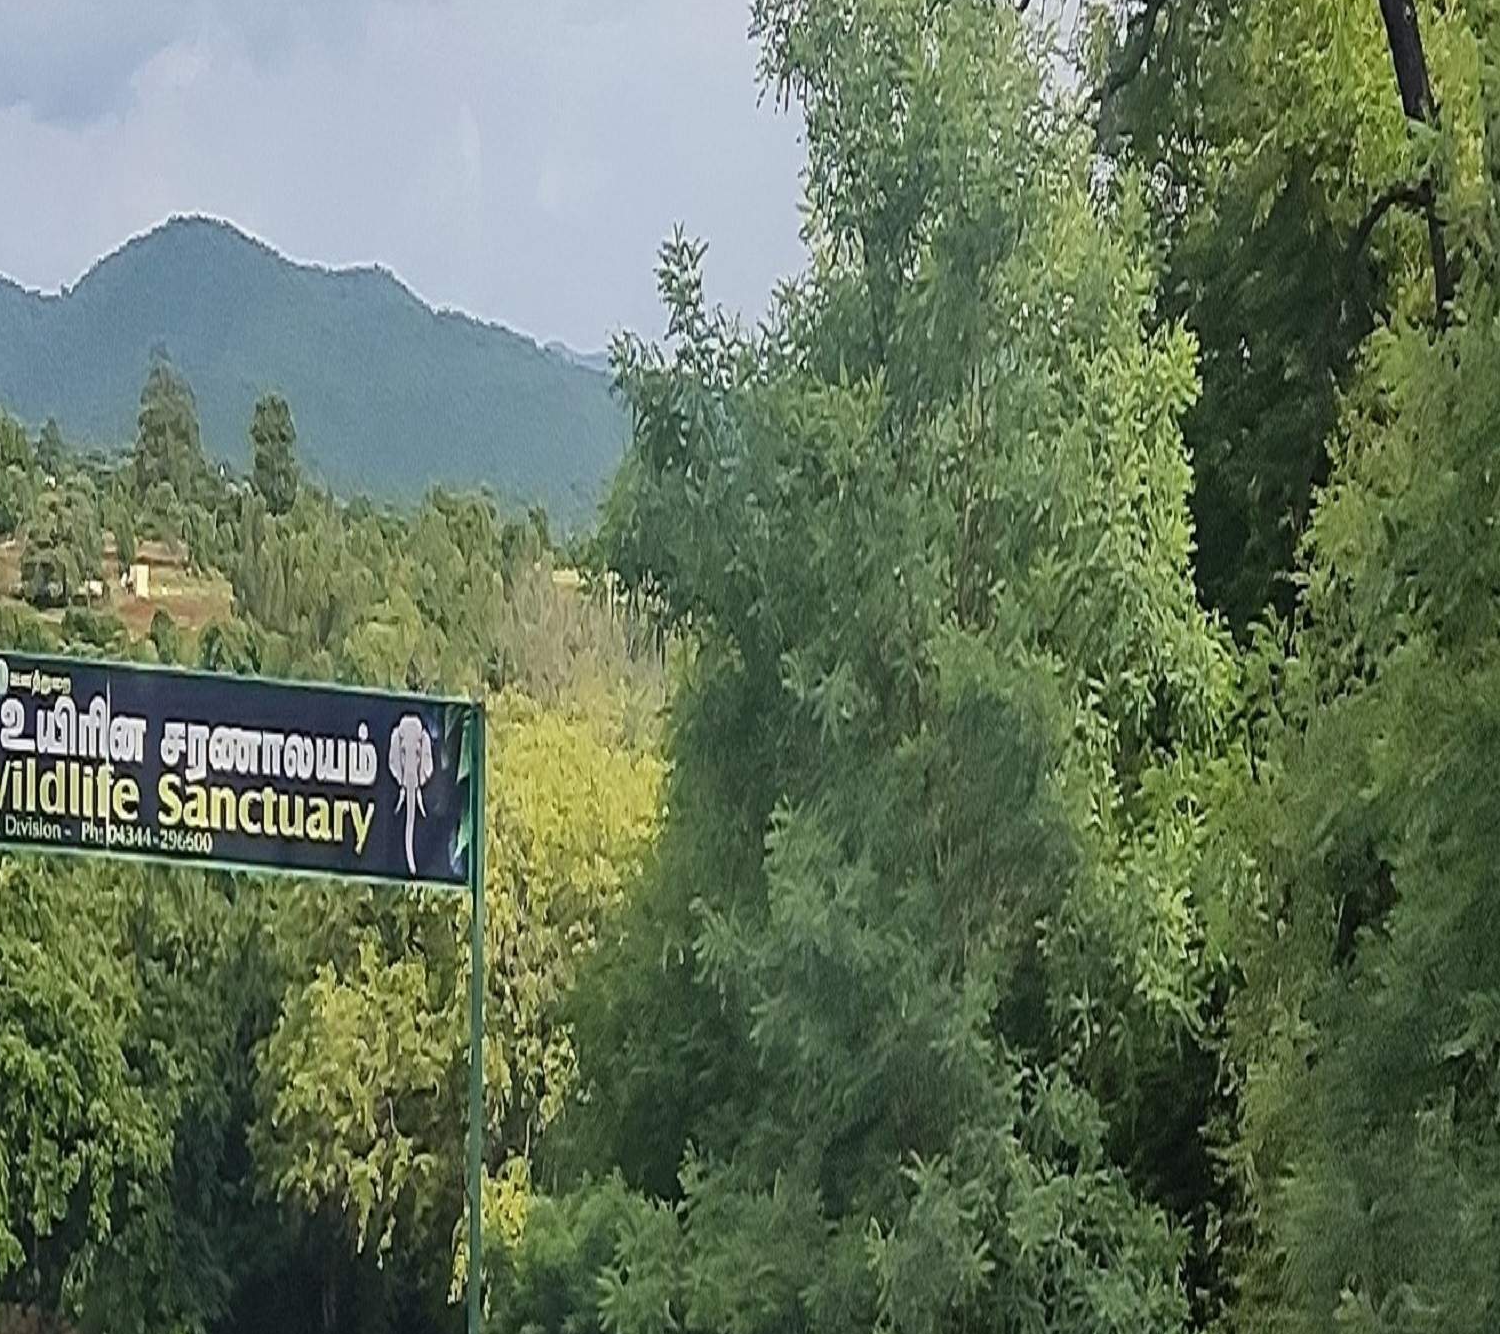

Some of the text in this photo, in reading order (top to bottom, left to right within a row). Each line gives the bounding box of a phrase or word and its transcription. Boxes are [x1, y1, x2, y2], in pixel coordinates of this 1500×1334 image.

[160, 721, 378, 785] சரணாலயம்
[5, 814, 62, 840] Division
[157, 772, 375, 855] Sanctuary
